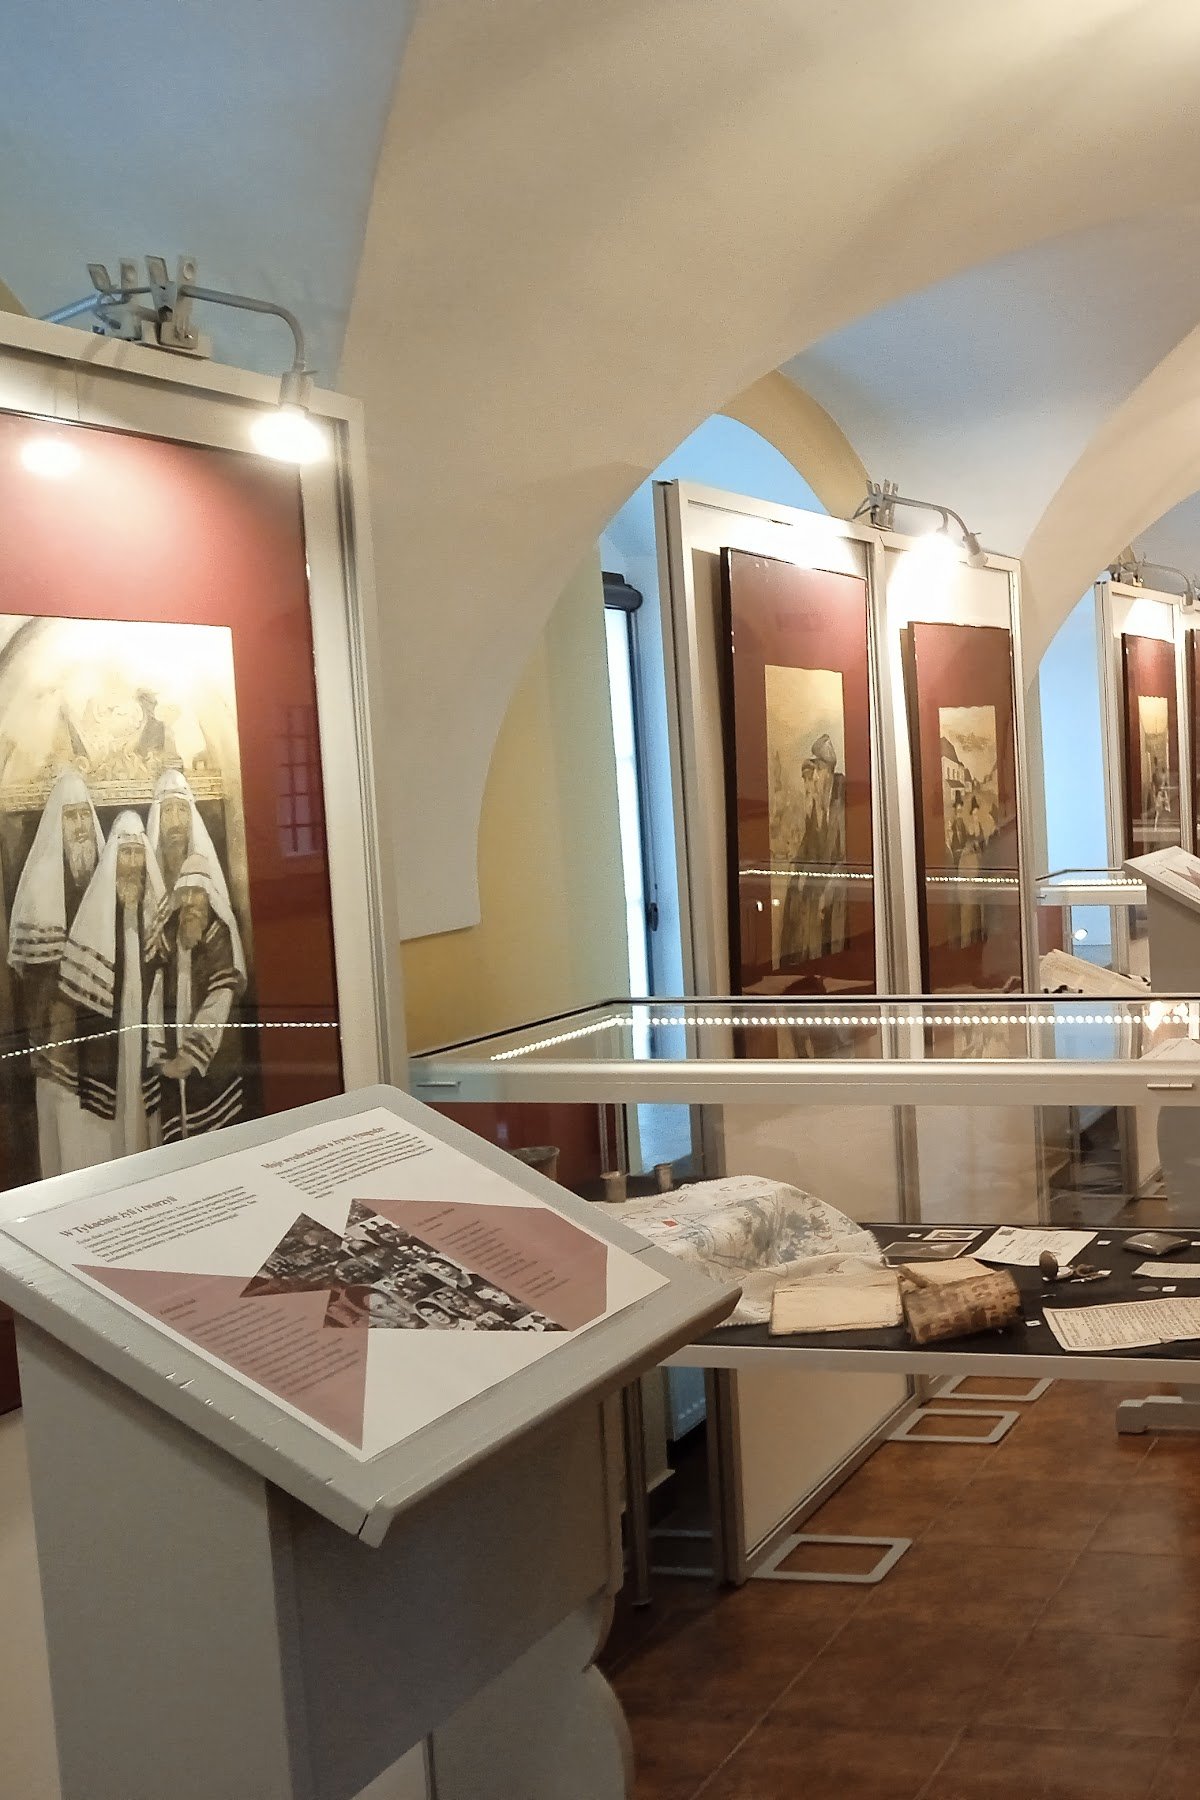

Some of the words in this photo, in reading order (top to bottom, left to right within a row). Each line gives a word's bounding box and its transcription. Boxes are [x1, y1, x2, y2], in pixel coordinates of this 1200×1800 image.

[59, 1229, 75, 1238] W
[72, 1215, 121, 1234] Tykocinie
[118, 1208, 138, 1219] żyli
[140, 1195, 178, 1213] tworzyli
